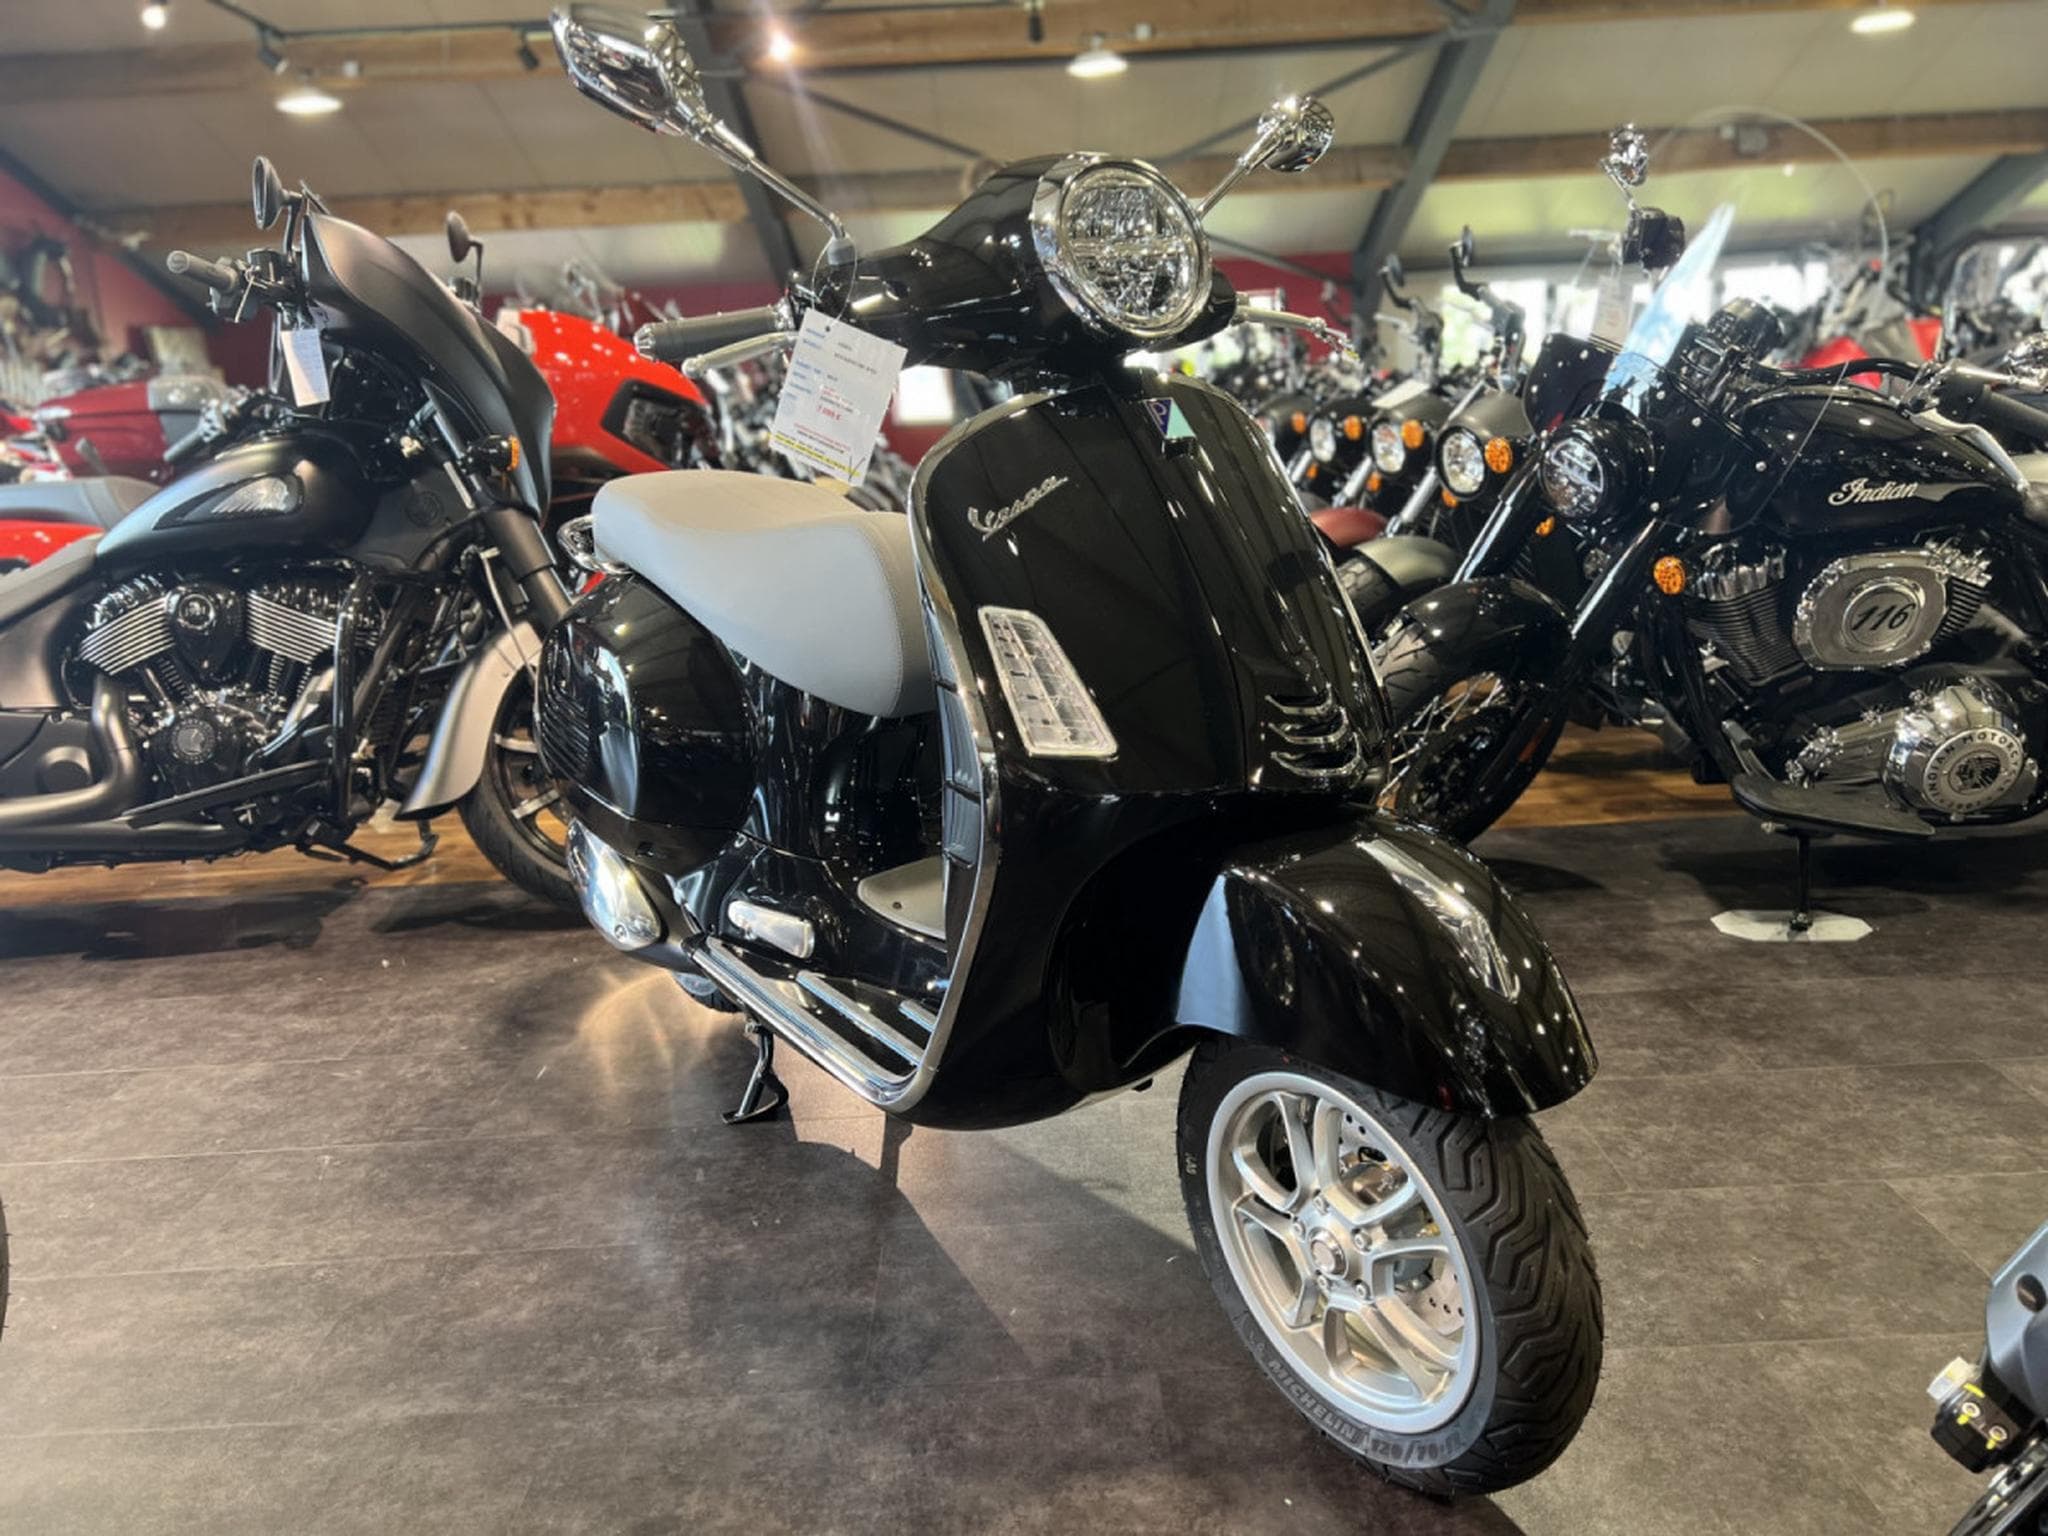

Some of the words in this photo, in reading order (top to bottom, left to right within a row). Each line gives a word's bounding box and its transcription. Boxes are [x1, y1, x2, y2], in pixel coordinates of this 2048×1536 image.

[967, 475, 1069, 542] Vespa
[1828, 477, 1919, 506] Indian
[1851, 602, 1917, 631] 116
[1928, 744, 1955, 797] INDIAN
[1267, 1359, 1356, 1441] MICHELIN
